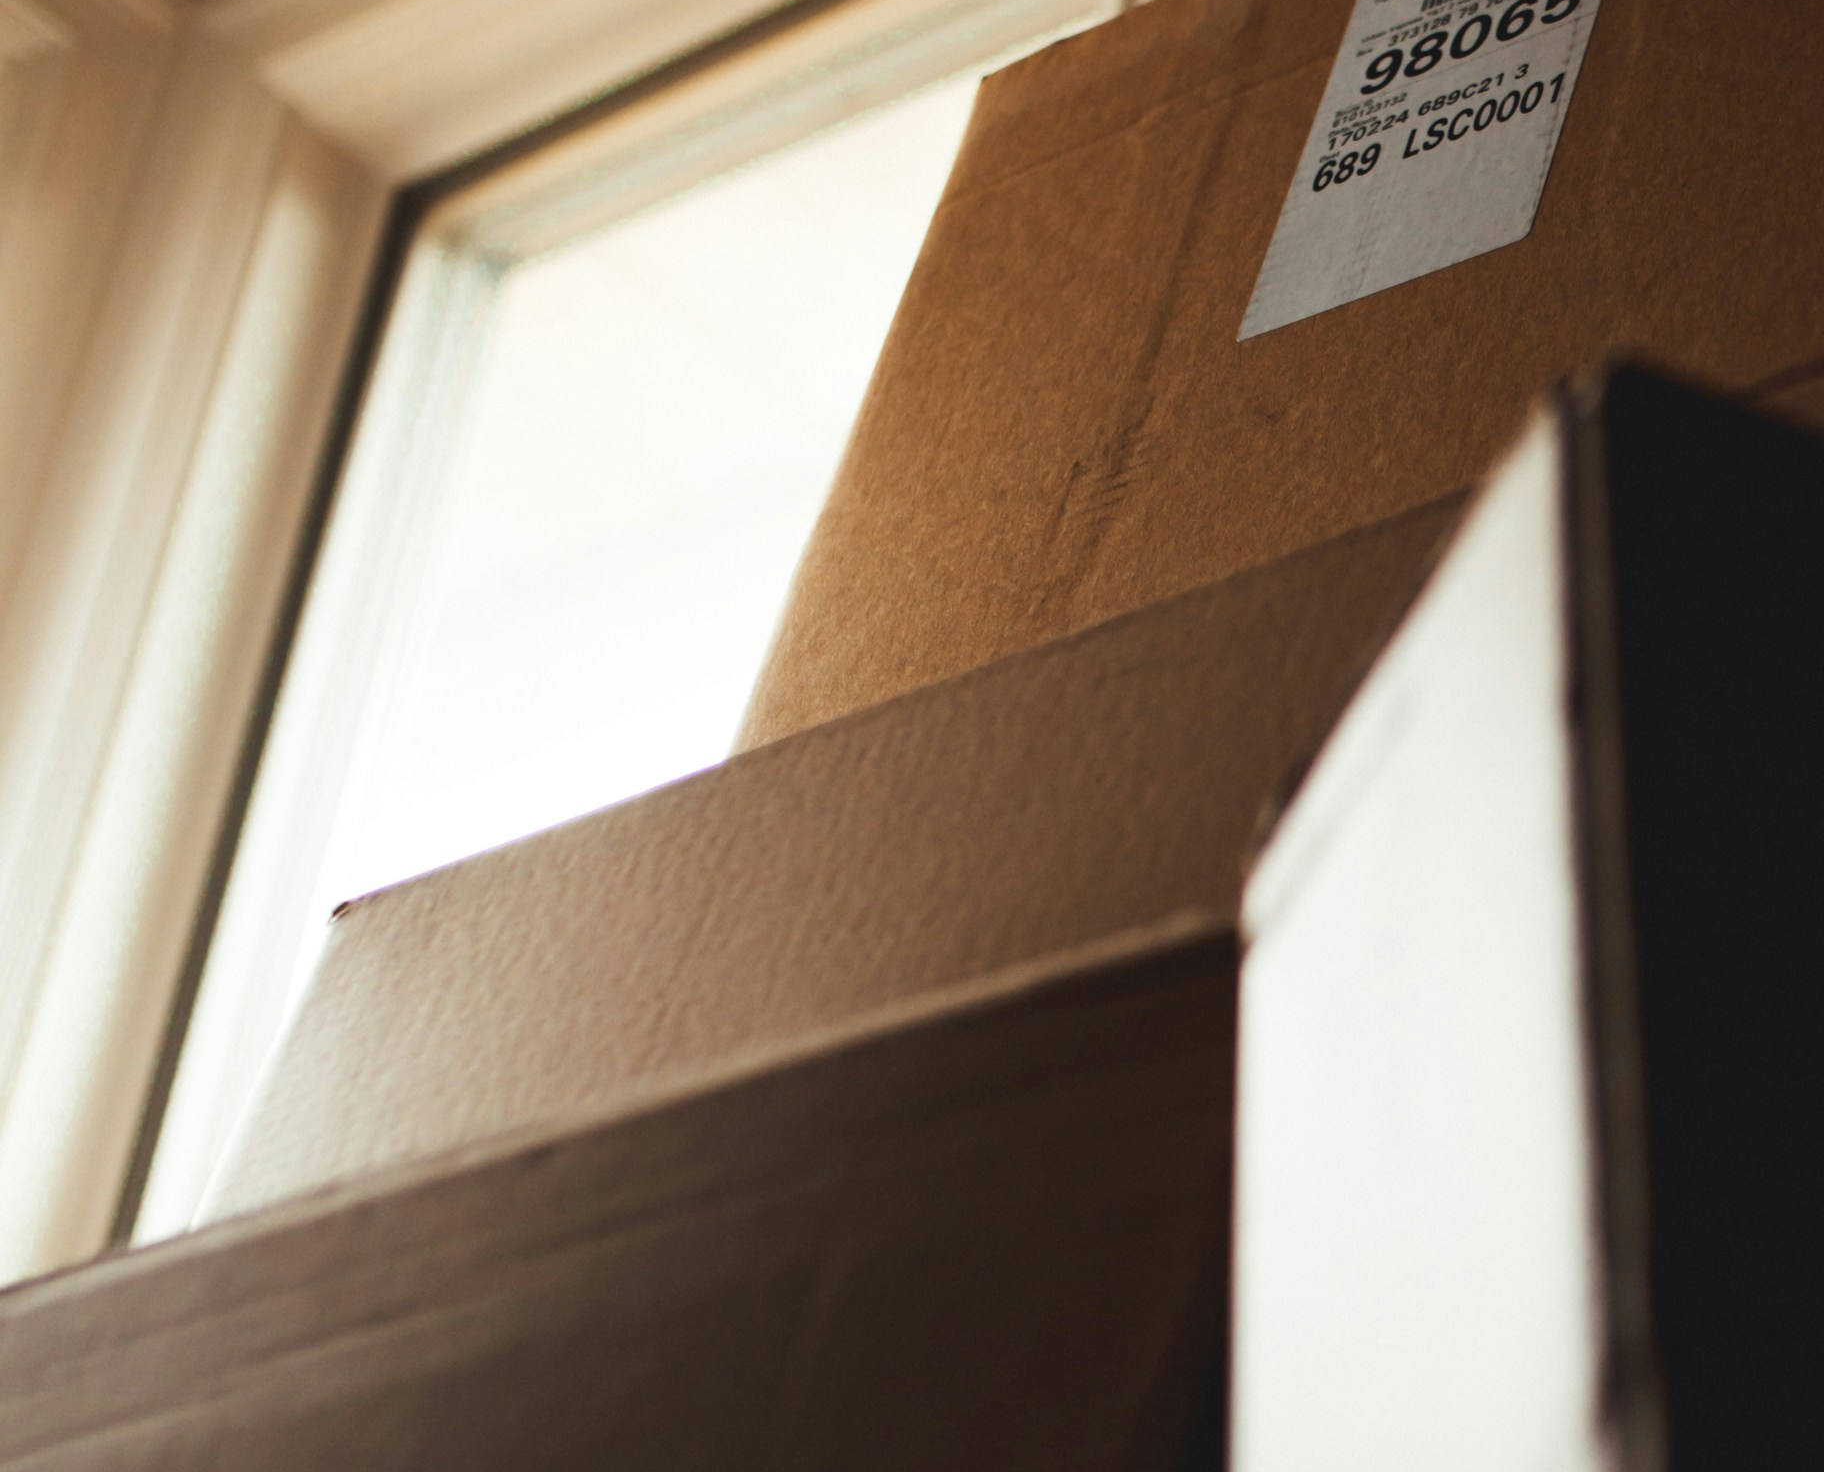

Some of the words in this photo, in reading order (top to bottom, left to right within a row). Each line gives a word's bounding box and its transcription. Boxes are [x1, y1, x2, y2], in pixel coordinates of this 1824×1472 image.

[1312, 142, 1382, 192] 689
[1402, 72, 1565, 159] LSC0001
[1327, 108, 1410, 151] 170224
[1418, 72, 1505, 117] 689C21
[1513, 63, 1530, 80] 3
